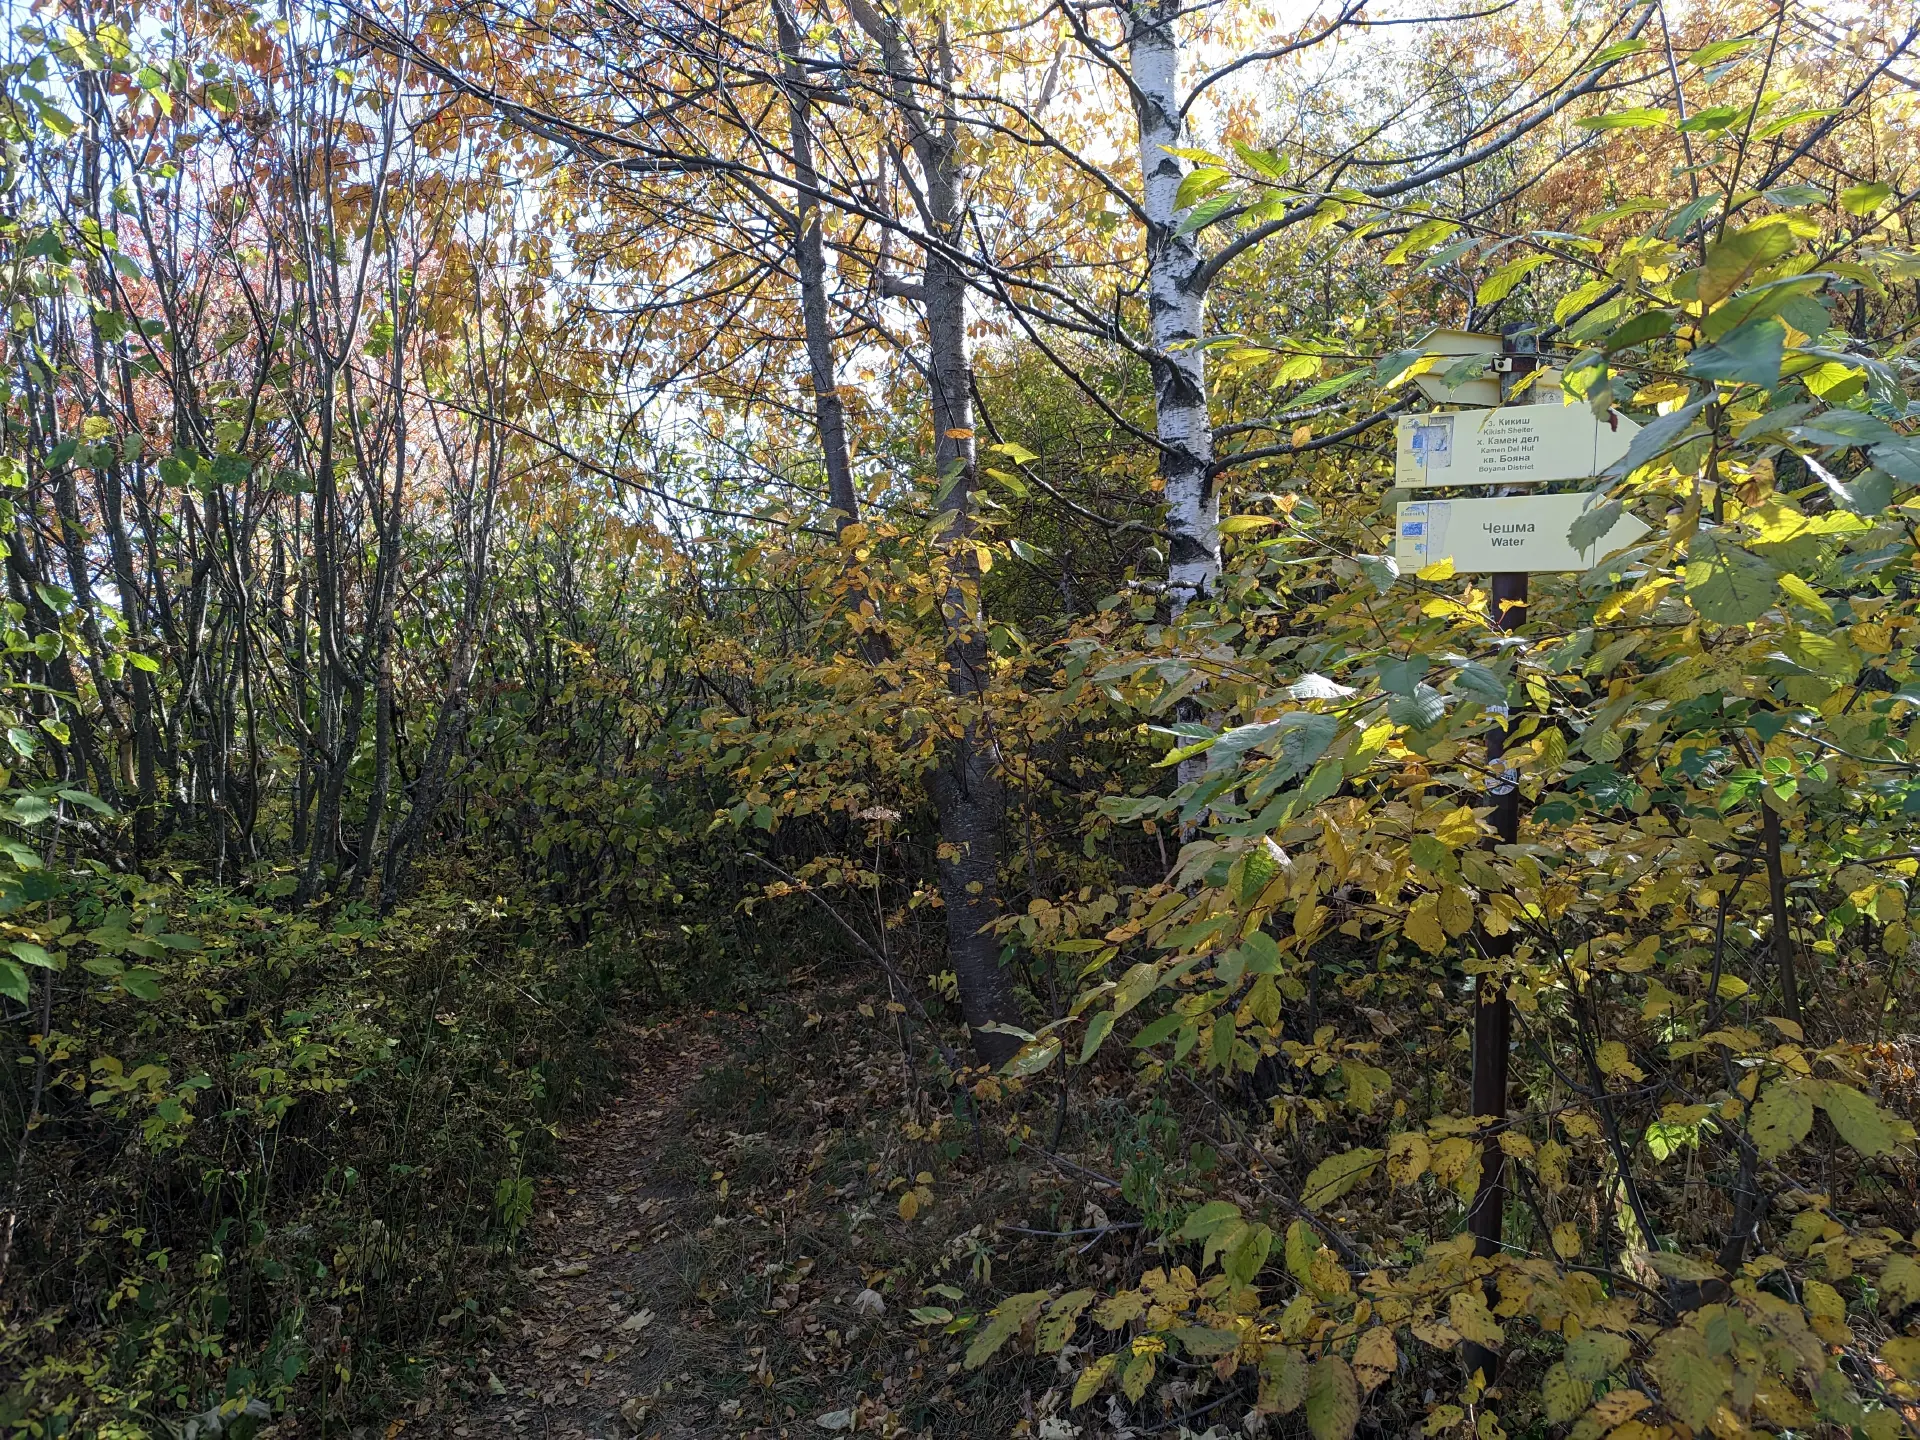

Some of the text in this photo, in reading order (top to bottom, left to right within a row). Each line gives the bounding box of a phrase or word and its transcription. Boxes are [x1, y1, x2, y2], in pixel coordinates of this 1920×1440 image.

[1498, 418, 1530, 426] Кикиш
[1483, 426, 1534, 435] Kikish Shelter
[1488, 437, 1518, 445] Камен
[1520, 435, 1540, 444] дел
[1480, 444, 1535, 454] Kamen Del Hut
[1499, 454, 1530, 463] Бояна
[1507, 463, 1534, 471] District
[1482, 521, 1536, 533] Чешма
[1490, 536, 1525, 548] Water
